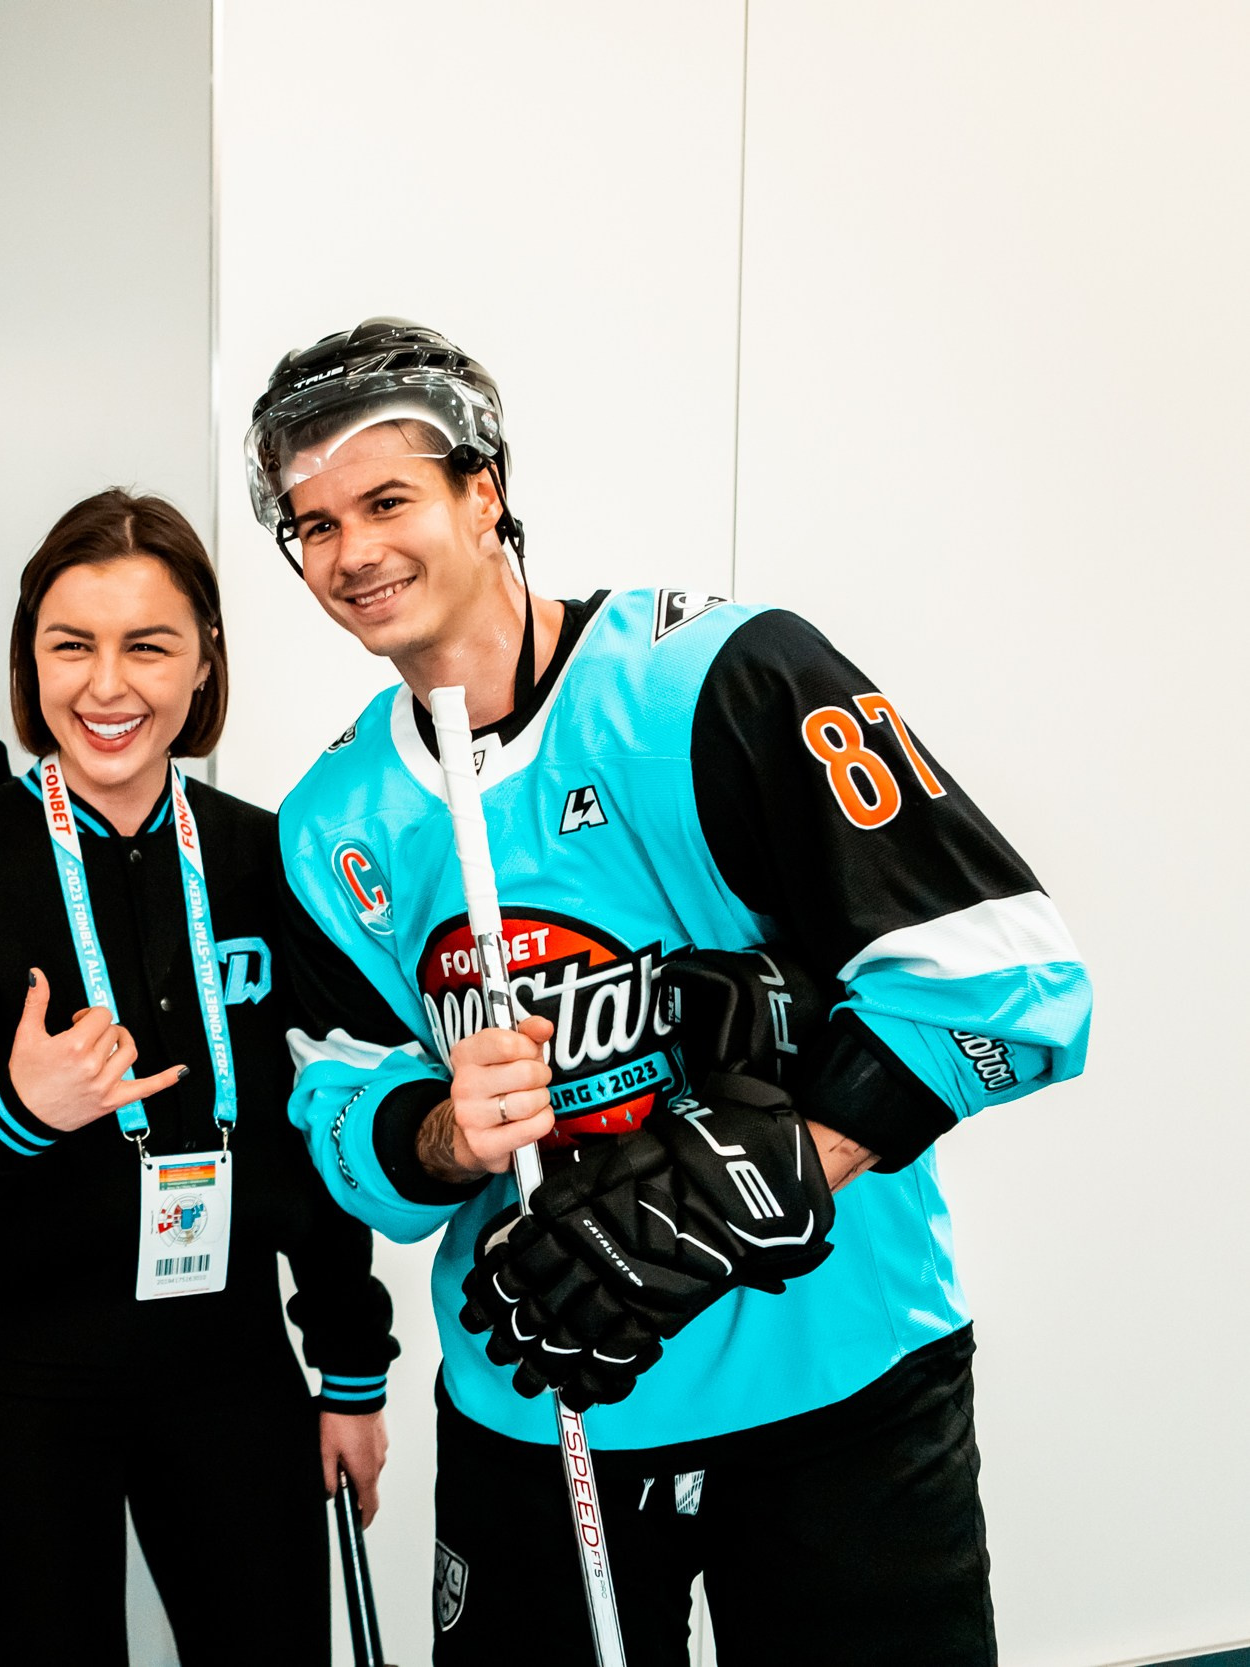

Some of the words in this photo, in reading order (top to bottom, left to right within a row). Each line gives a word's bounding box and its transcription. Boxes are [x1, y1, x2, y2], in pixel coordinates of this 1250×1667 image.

[294, 365, 345, 389] TRUE
[801, 692, 947, 830] 87
[44, 764, 72, 835] FONBET
[65, 867, 83, 902] 2023
[187, 879, 204, 919] WEEK
[340, 847, 387, 911] C
[73, 903, 97, 956] FONBET
[193, 921, 216, 985] ALL-STAR
[85, 960, 109, 1008] ALL-ST
[203, 987, 224, 1043] FONBET
[215, 1045, 229, 1077] 2023
[609, 1061, 658, 1093] 2023
[583, 1219, 630, 1273] CATALYST
[562, 1411, 600, 1547] TSPEED
